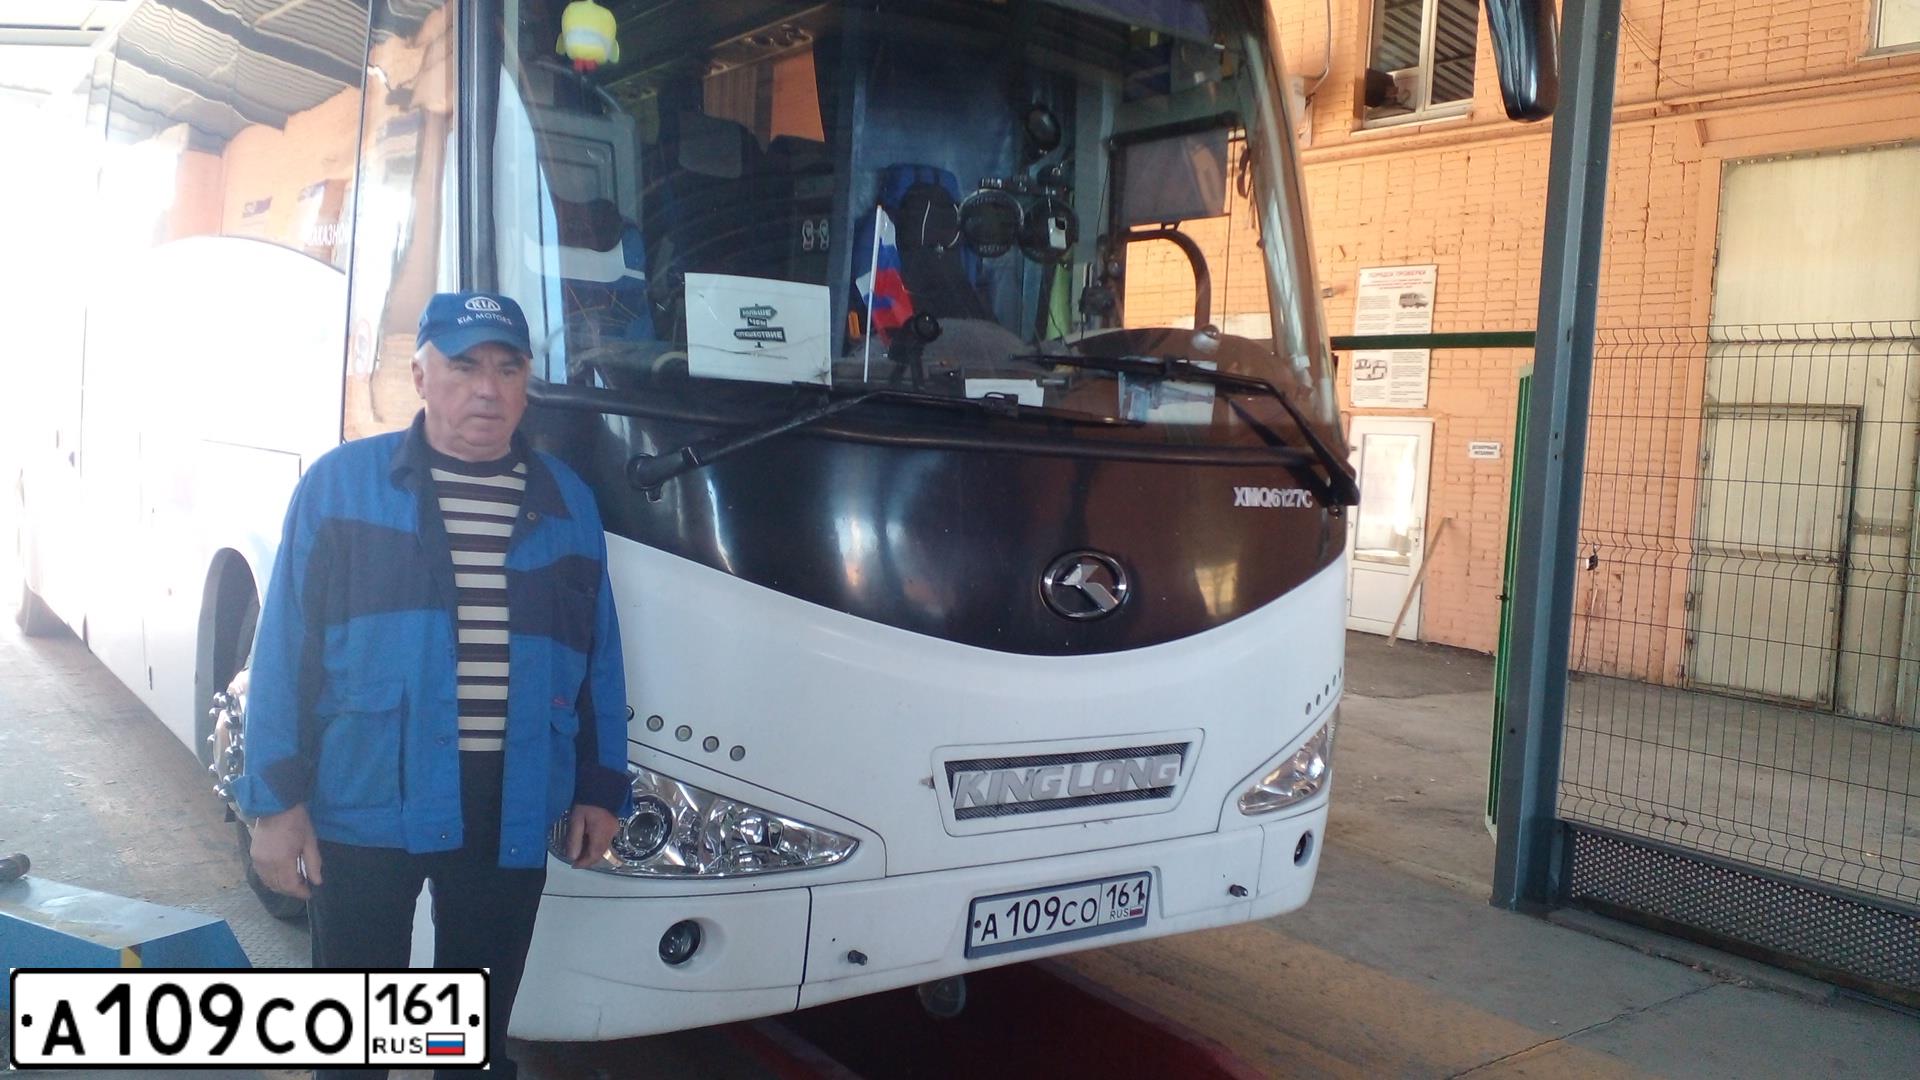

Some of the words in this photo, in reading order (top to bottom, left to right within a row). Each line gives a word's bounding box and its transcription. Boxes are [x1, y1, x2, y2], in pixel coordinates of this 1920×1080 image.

[472, 300, 496, 310] KIA
[457, 315, 473, 325] KIA
[475, 312, 513, 325] MOTORS
[1233, 487, 1313, 508] XMQ6127C
[1106, 880, 1145, 910] 161
[1109, 907, 1129, 920] RUS
